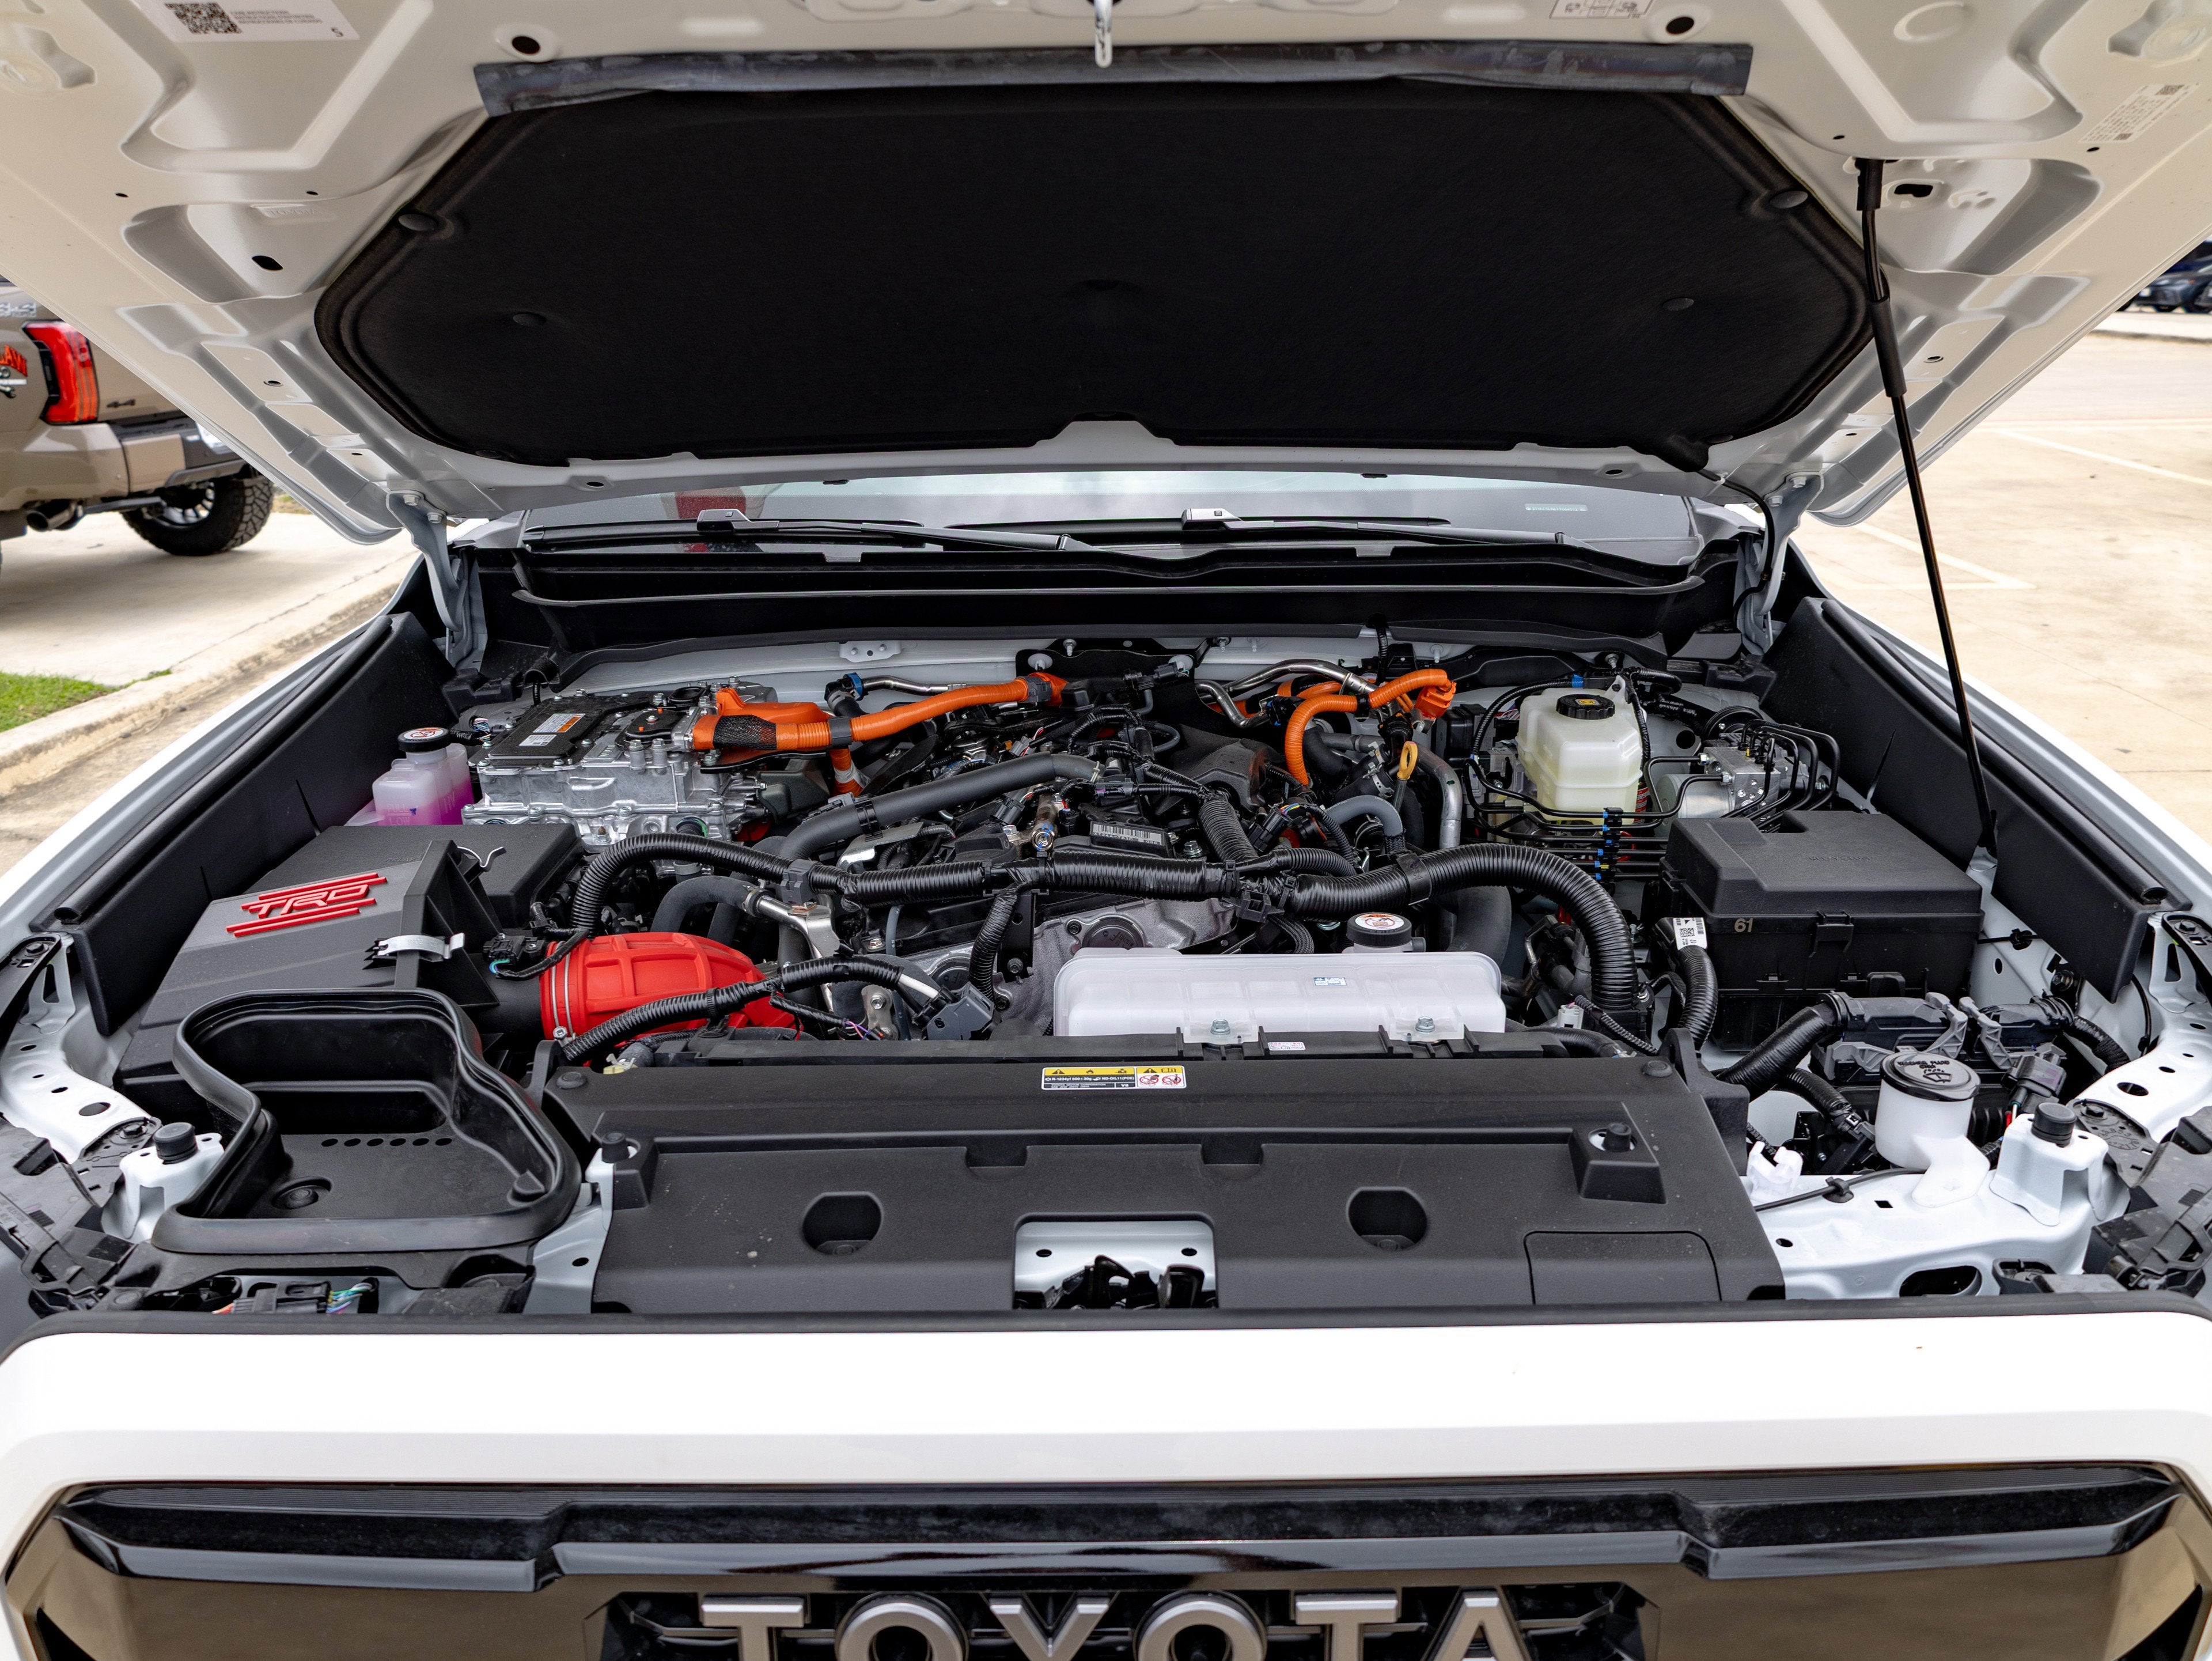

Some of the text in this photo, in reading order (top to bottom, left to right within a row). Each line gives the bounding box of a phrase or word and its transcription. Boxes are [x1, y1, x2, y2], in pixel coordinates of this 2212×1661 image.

[389, 816, 410, 826] LOW
[249, 884, 369, 919] TRD
[1734, 918, 1753, 933] 61
[701, 1594, 1532, 1661] TOYOTA
